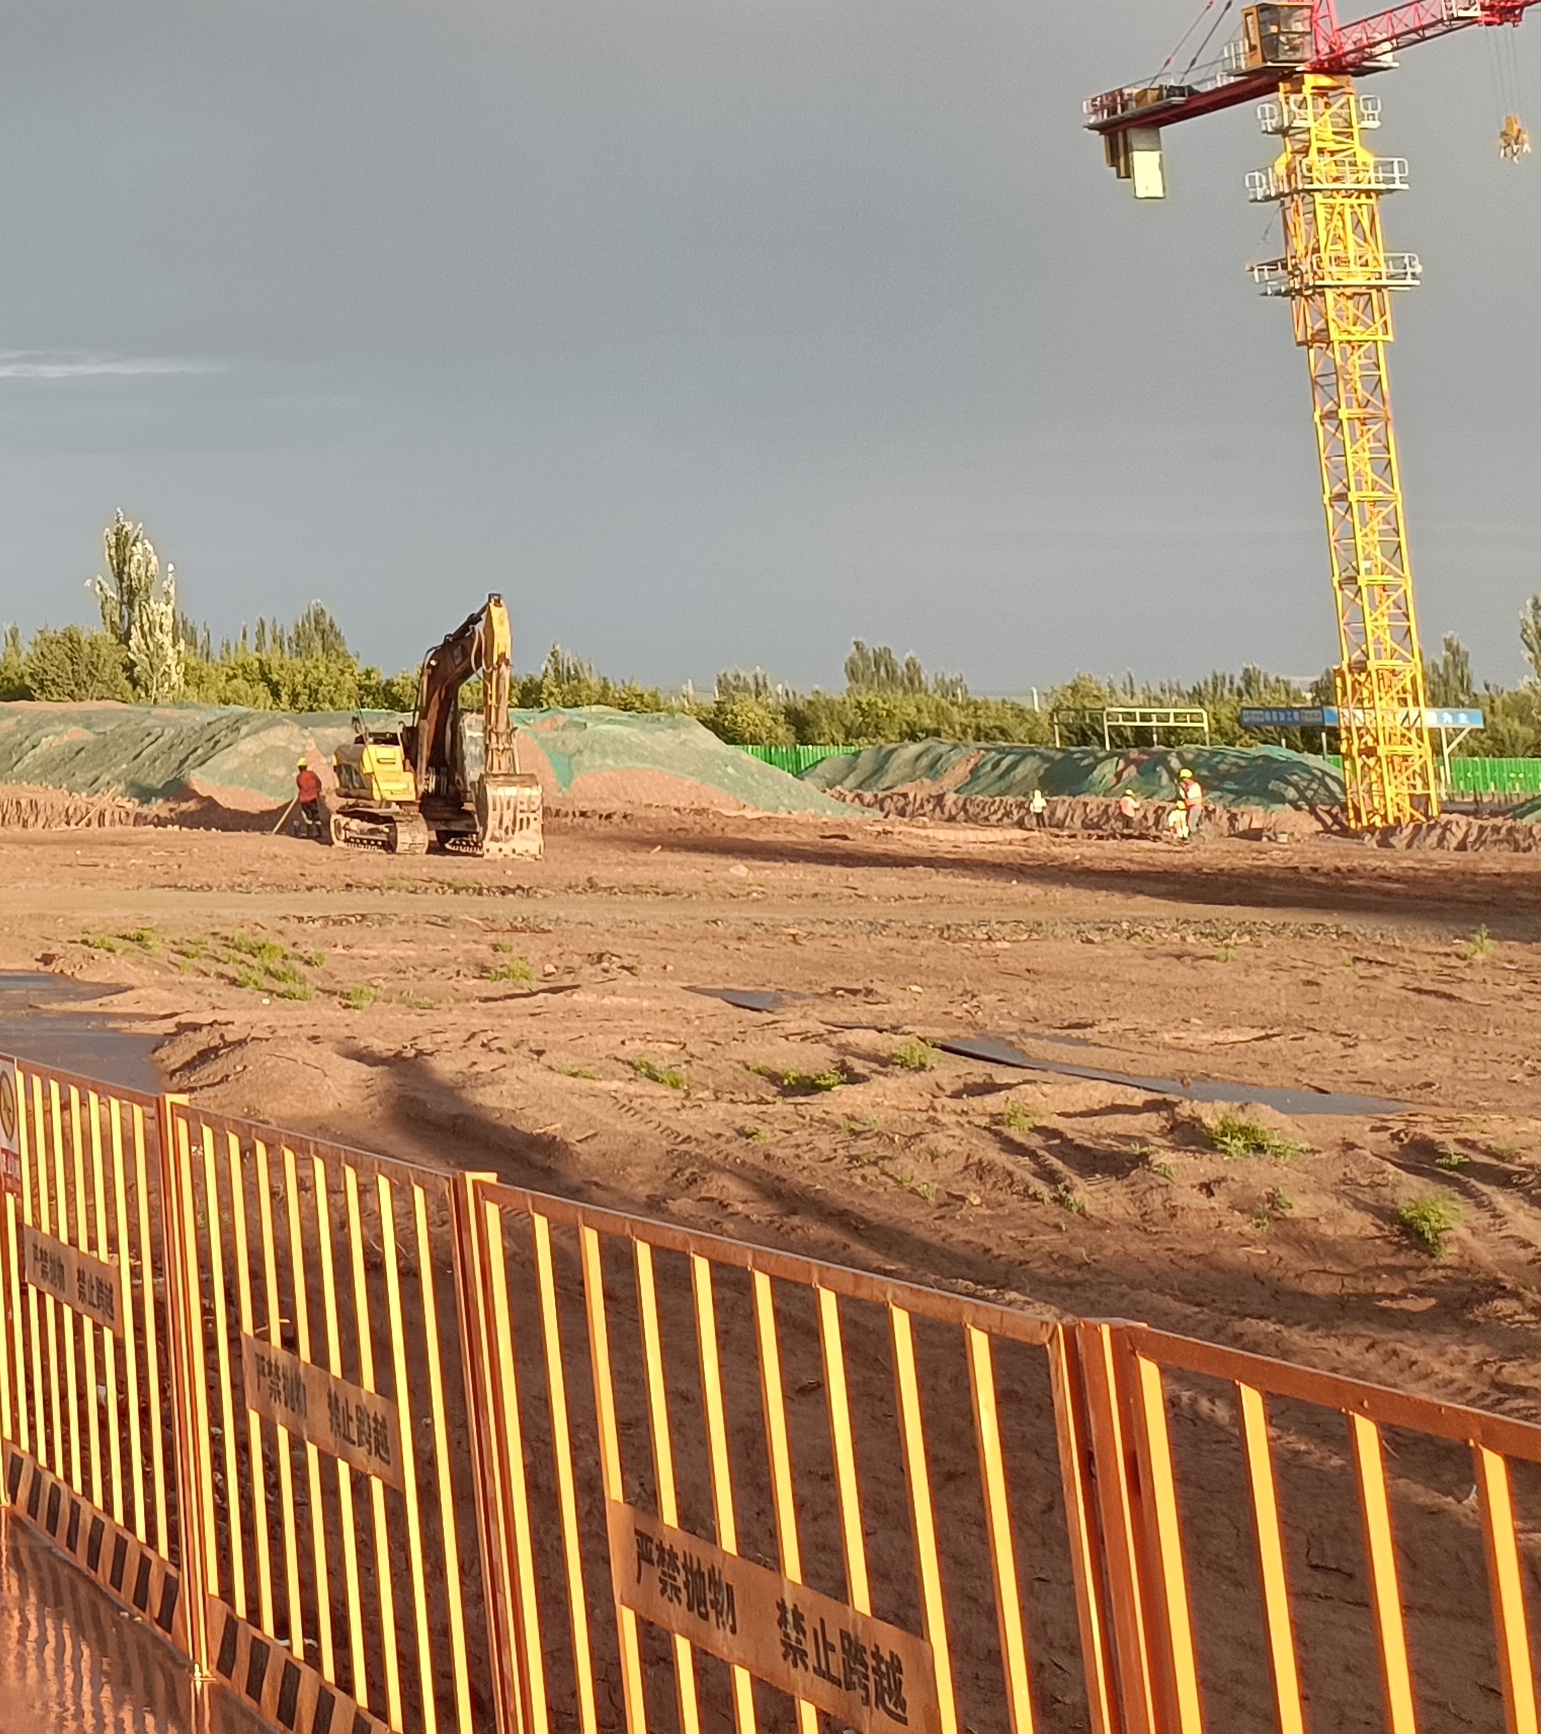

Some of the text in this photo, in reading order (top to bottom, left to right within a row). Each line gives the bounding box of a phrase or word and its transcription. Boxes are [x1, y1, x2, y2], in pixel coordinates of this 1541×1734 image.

[327, 1387, 391, 1466] 禁止跨越
[634, 1528, 908, 1726] 严禁抛物 禁止跨越
